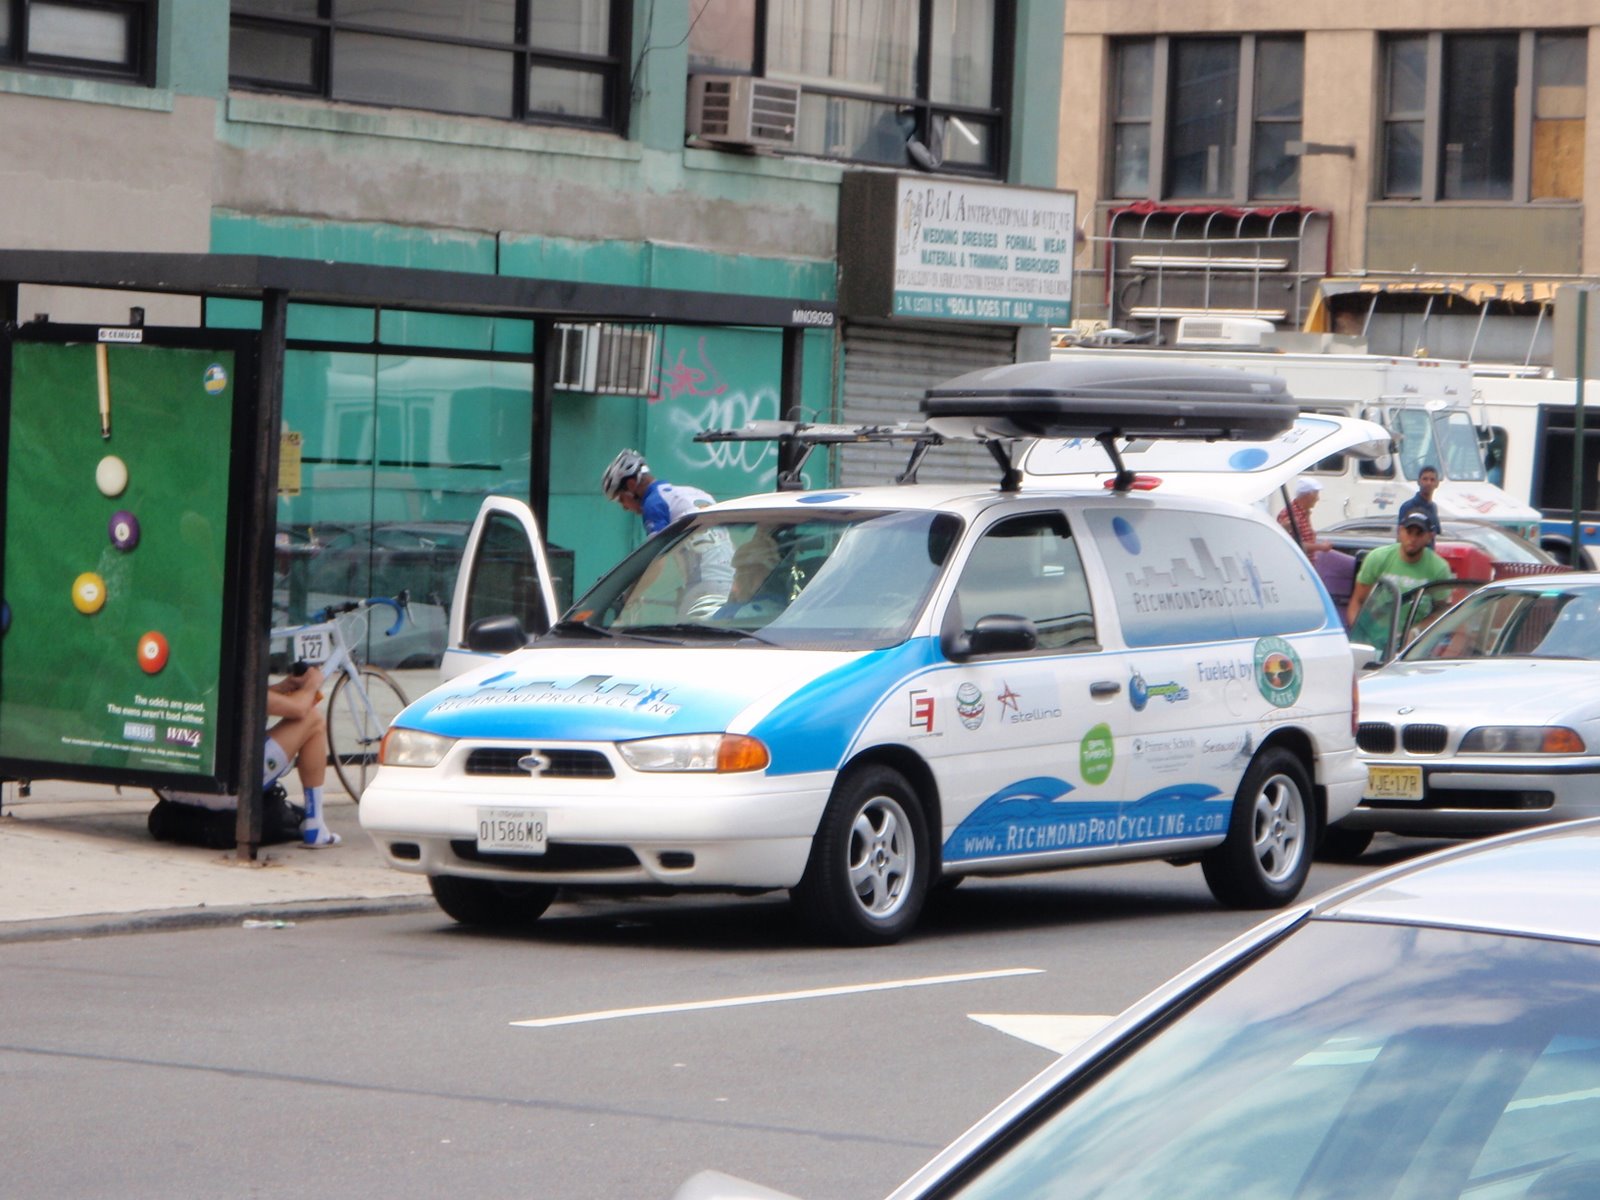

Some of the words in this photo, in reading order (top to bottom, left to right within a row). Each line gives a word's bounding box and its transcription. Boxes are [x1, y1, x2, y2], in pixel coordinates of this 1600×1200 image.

[923, 228, 958, 245] WEDDING
[962, 231, 998, 248] DRESSES
[1006, 234, 1037, 251] FORMAL
[1043, 237, 1067, 254] WEAR
[921, 249, 957, 266] MATERIAL
[969, 253, 1008, 271] TRIMMINGS
[977, 299, 1000, 317] DOES
[1002, 300, 1011, 317] IT
[108, 329, 142, 340] CEMUSA
[301, 641, 323, 659] 127
[1197, 660, 1235, 681] Fueled
[1239, 659, 1252, 682] by
[107, 703, 121, 715] The
[135, 694, 148, 706] The
[149, 697, 169, 708] odds
[166, 727, 201, 747] WIN4
